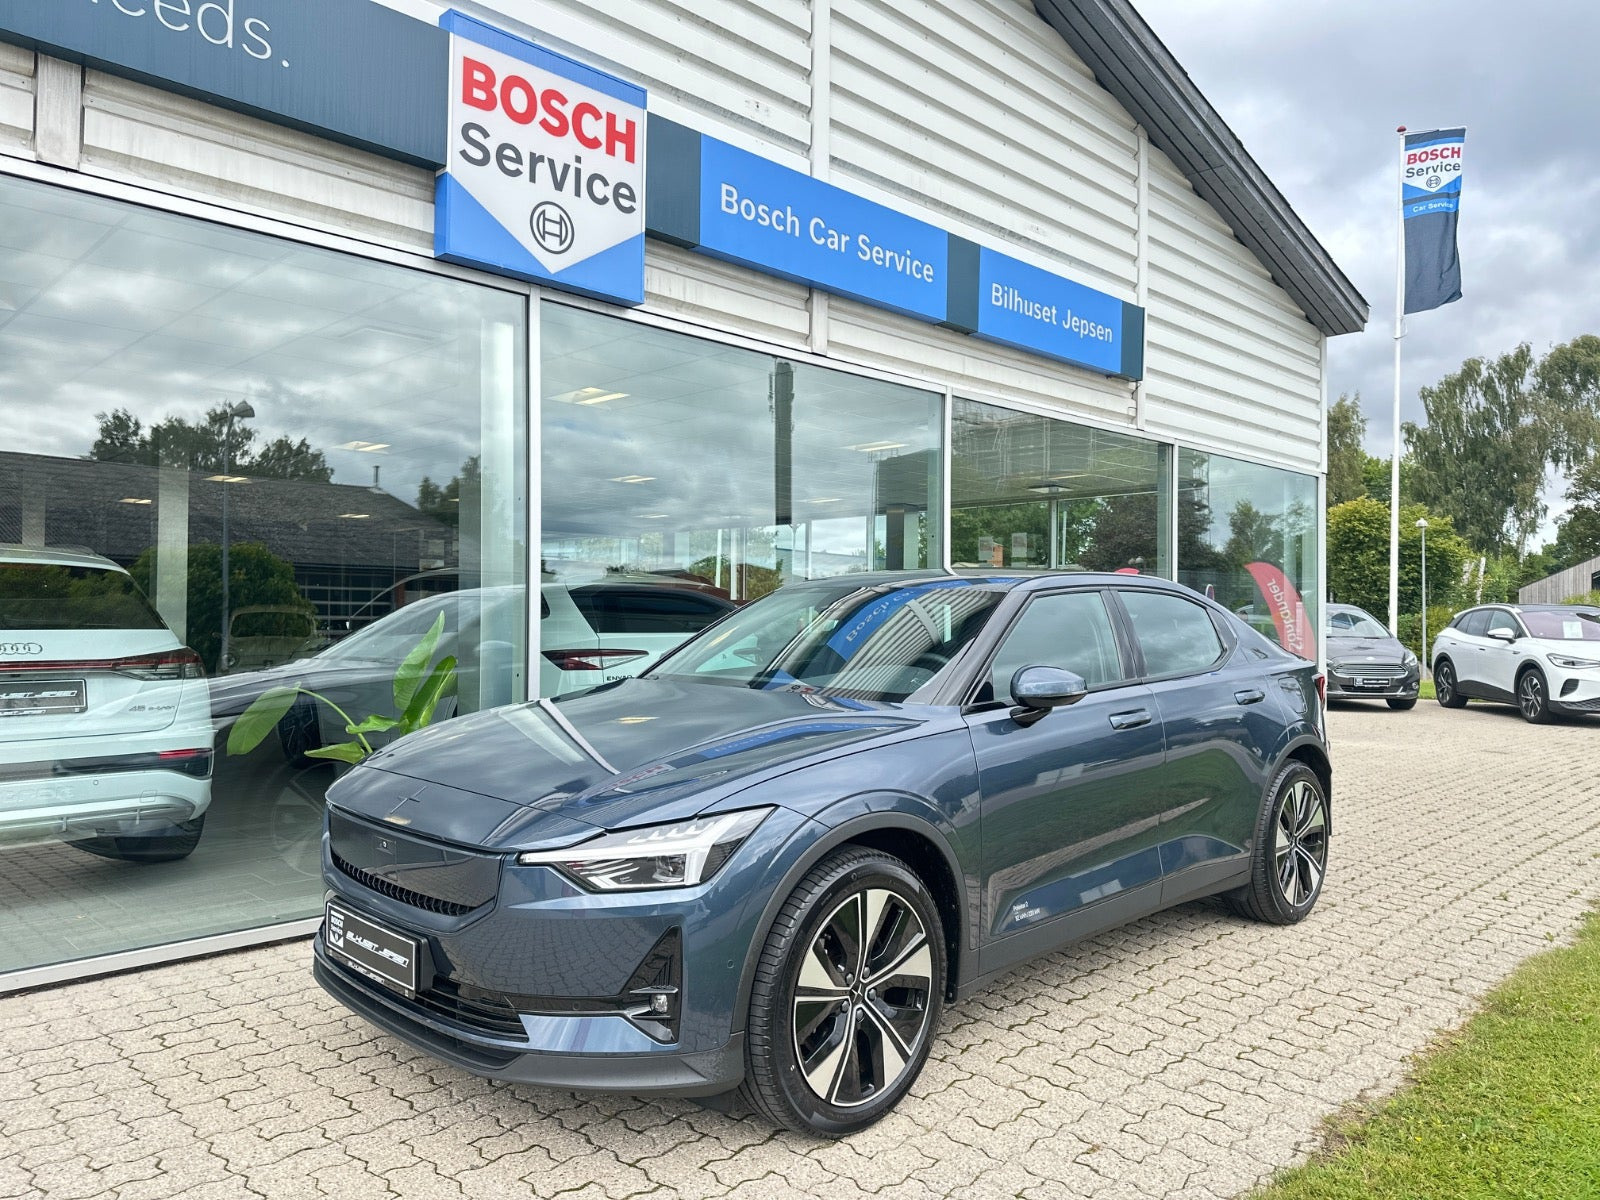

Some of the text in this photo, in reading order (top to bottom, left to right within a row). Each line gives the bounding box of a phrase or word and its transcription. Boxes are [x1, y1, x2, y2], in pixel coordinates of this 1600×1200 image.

[462, 55, 636, 164] BOSCH
[459, 122, 637, 215] Service
[1406, 161, 1461, 178] Service
[1407, 147, 1461, 165] BOSCH
[720, 182, 935, 284] Bosch Car Service
[1412, 201, 1455, 213] Car Service
[991, 282, 1114, 343] Bilhuset Jepsen
